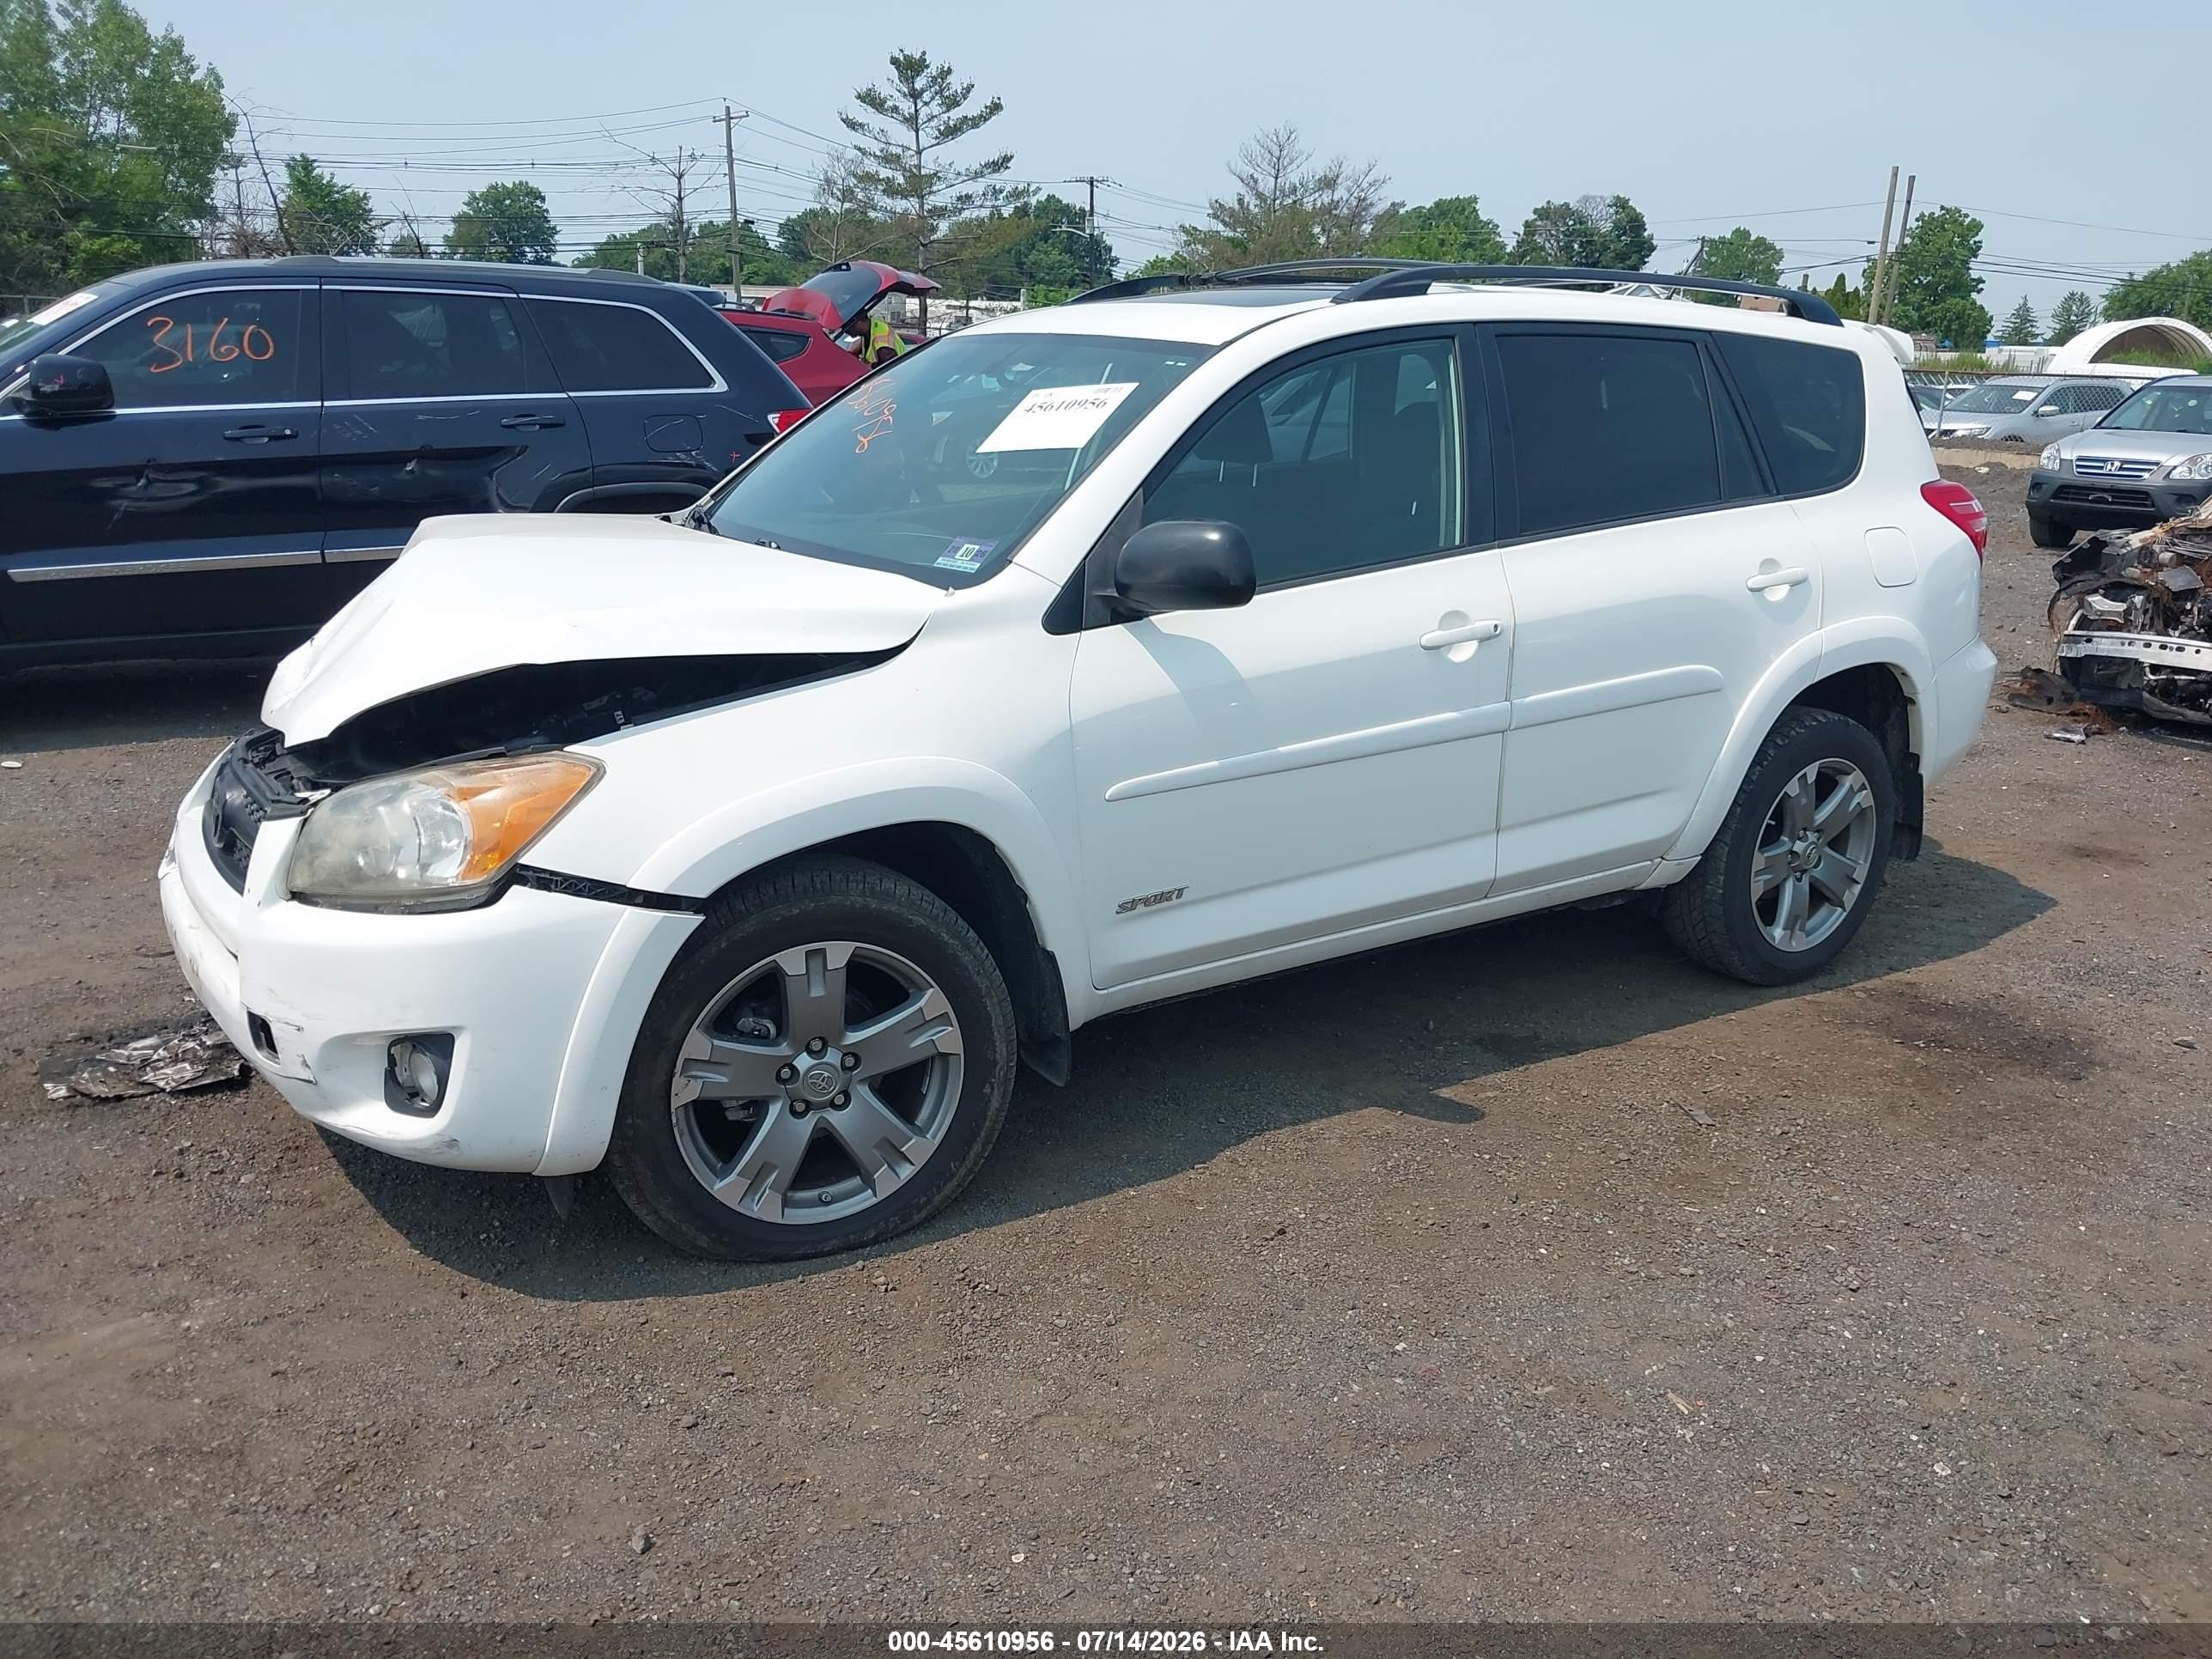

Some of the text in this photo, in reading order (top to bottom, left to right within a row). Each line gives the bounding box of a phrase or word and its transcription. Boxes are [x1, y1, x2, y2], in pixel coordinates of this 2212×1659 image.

[146, 316, 276, 374] 3160
[1024, 397, 1109, 413] 45610956
[959, 546, 975, 558] 10
[1115, 884, 1190, 915] SPORT
